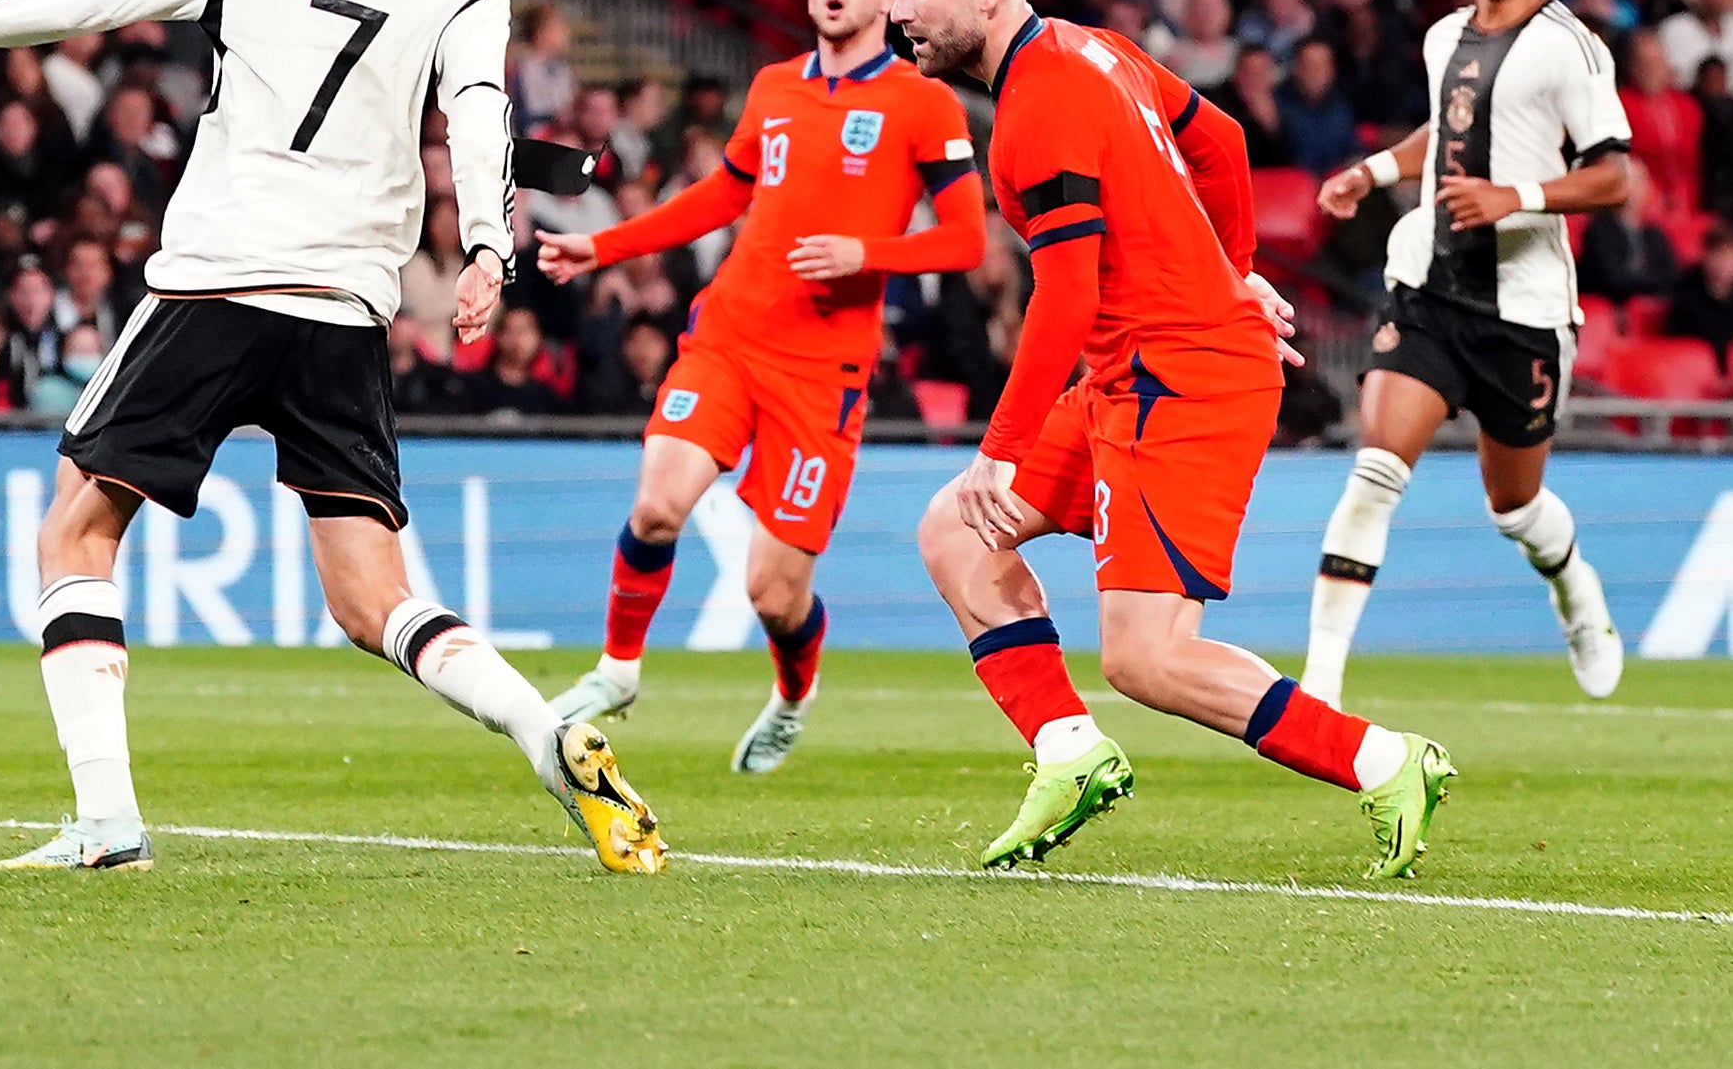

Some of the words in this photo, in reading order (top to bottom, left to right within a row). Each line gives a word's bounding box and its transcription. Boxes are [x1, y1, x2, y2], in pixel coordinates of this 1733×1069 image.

[761, 133, 790, 187] 19
[1530, 358, 1553, 409] 5
[780, 448, 827, 509] 19
